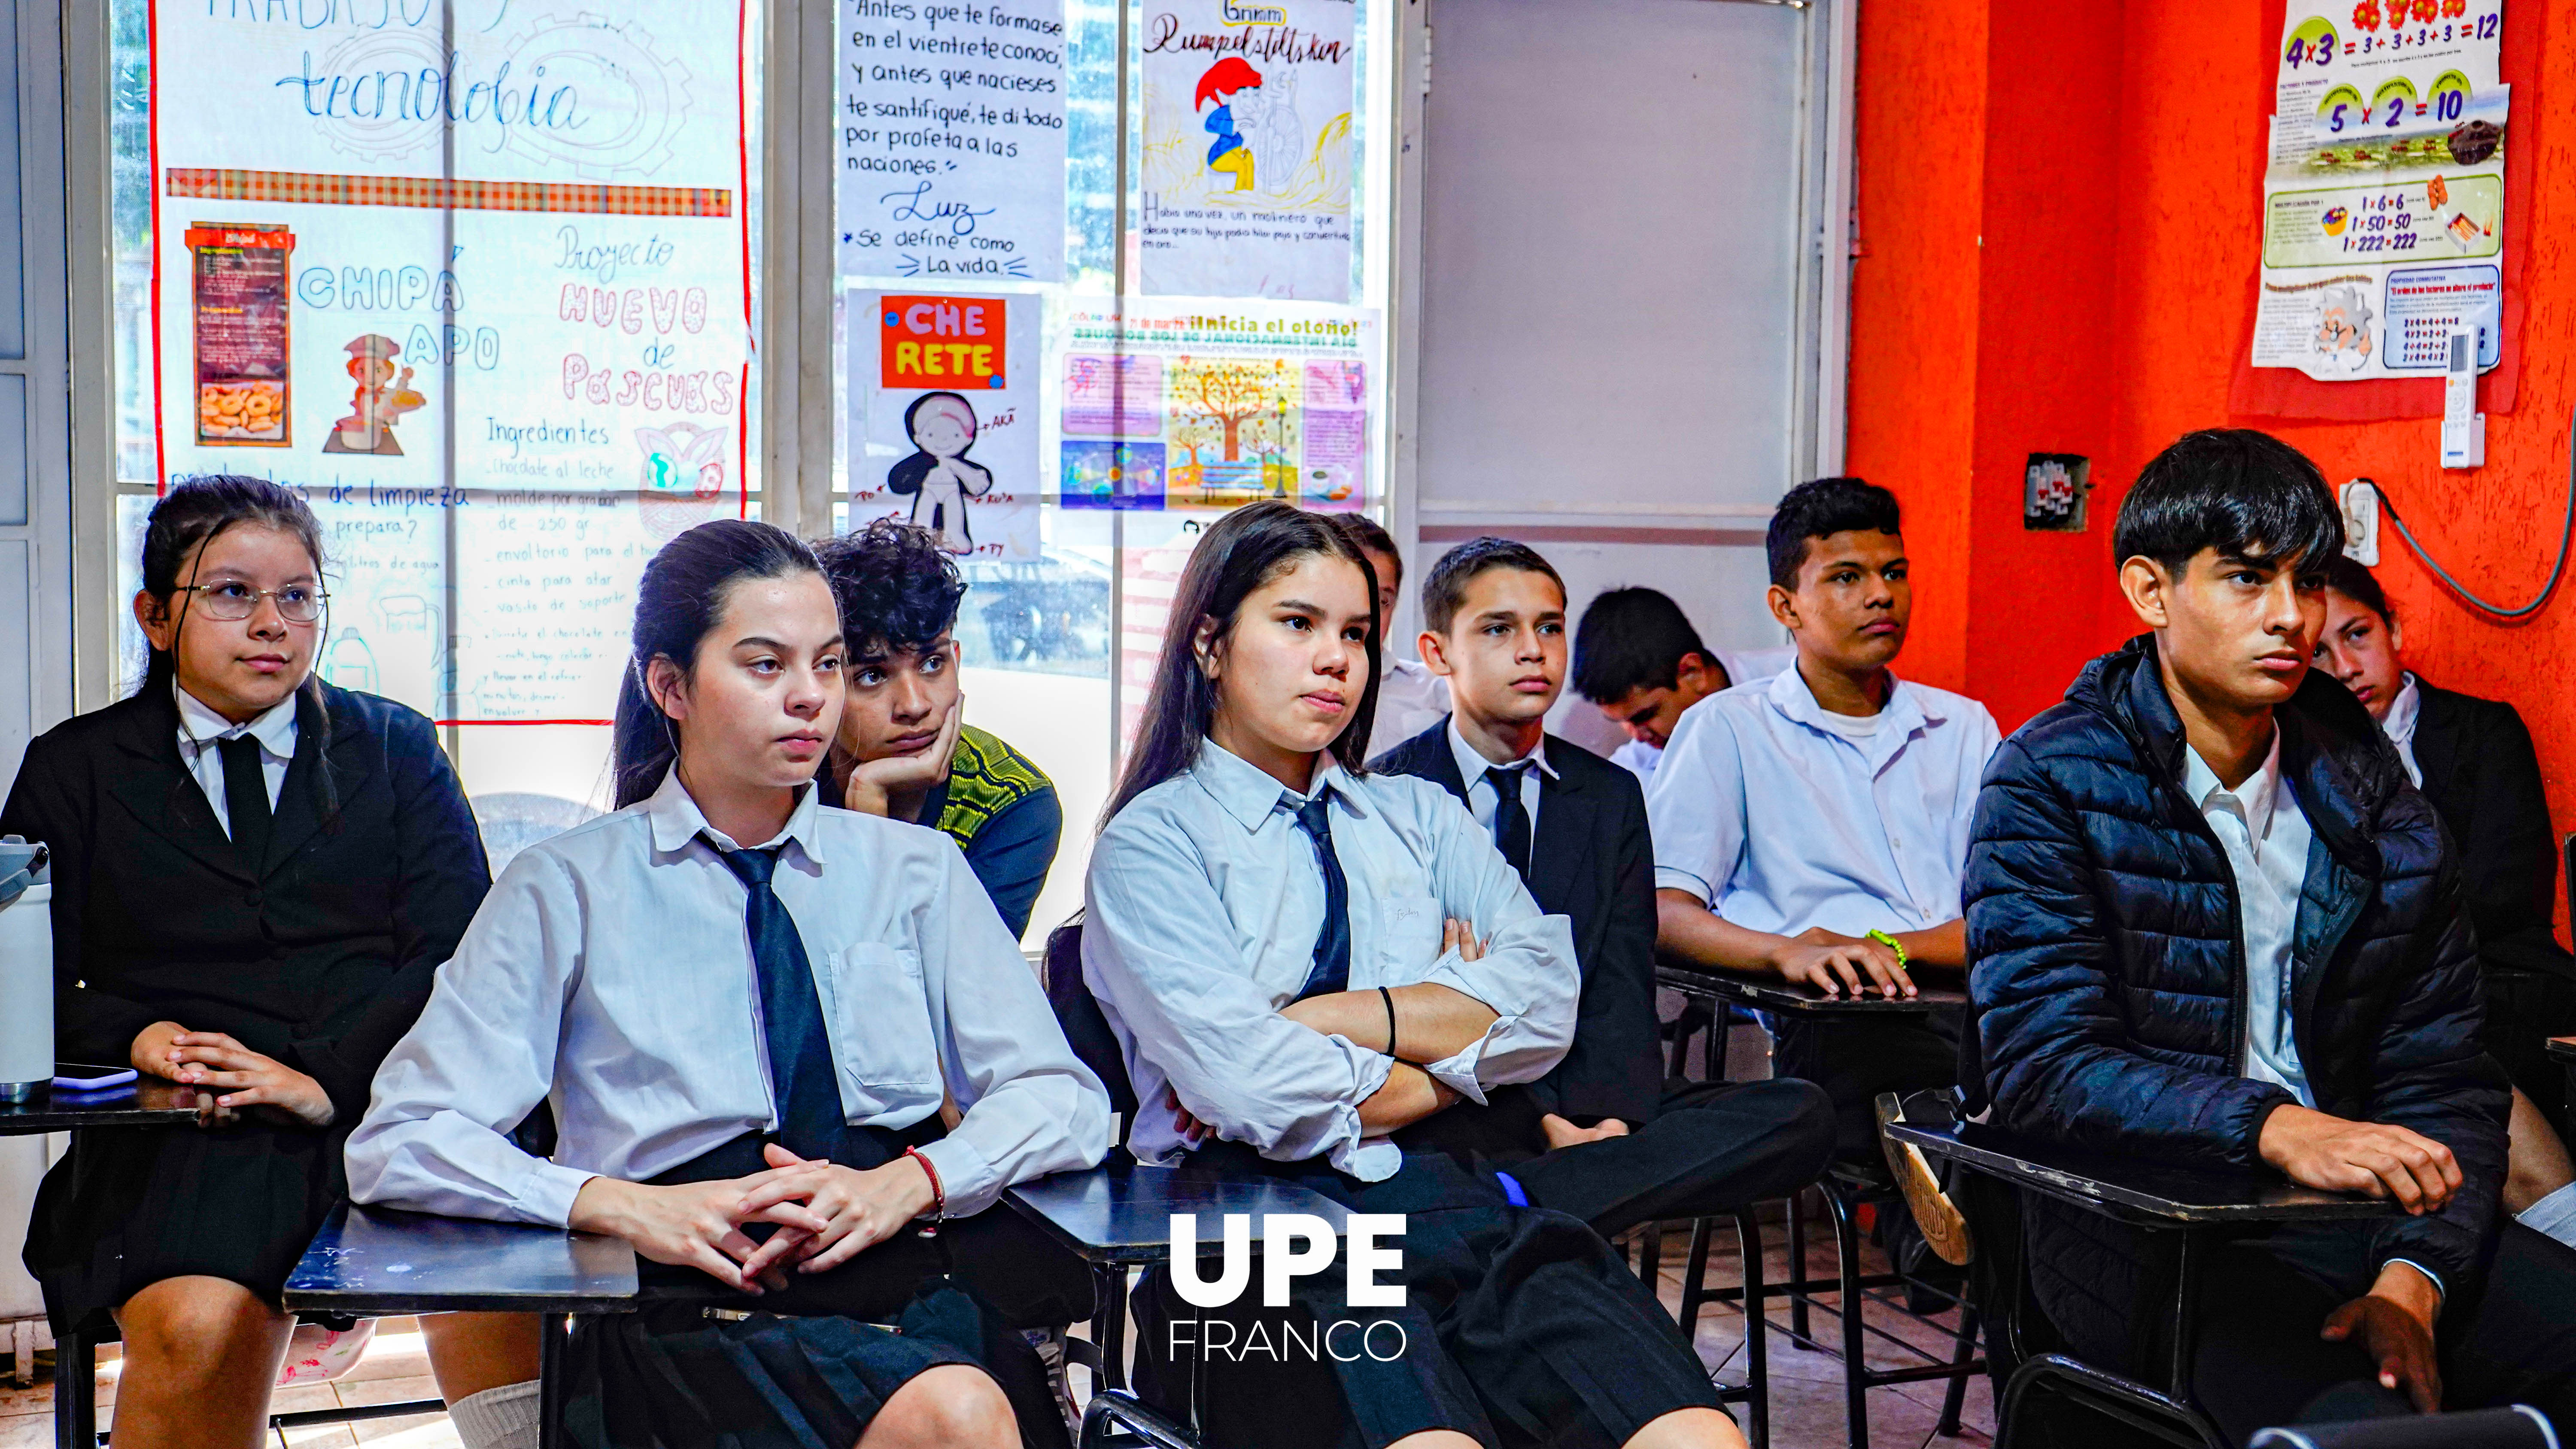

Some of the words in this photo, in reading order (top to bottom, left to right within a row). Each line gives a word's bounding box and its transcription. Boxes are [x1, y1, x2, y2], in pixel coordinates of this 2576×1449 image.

[925, 5, 959, 31] que
[964, 3, 983, 24] te
[990, 6, 1063, 36] formase
[2477, 13, 2498, 40] 12
[853, 31, 876, 48] en
[884, 30, 901, 49] el
[909, 36, 978, 56] vientre
[981, 37, 999, 59] te
[872, 65, 931, 84] antes
[940, 69, 972, 90] que
[978, 72, 1056, 93] nacieses
[846, 94, 868, 117] te
[979, 104, 997, 124] te
[1003, 109, 1018, 124] di
[1022, 107, 1063, 129] todo
[2330, 103, 2348, 133] 5
[2385, 98, 2403, 128] 2
[2438, 90, 2463, 122] 10
[846, 126, 880, 147] por
[889, 127, 962, 151] profeta
[966, 137, 980, 152] a
[987, 137, 1018, 158] las
[880, 181, 996, 235] Luz
[1230, 211, 1247, 221] un
[1314, 215, 1334, 230] que
[555, 225, 674, 284] Proyecto
[856, 229, 882, 247] Se
[895, 228, 959, 250] define
[970, 236, 1015, 252] como
[927, 256, 951, 273] La
[560, 283, 707, 334] HUEVO
[905, 303, 987, 337] CHE
[1266, 318, 1284, 333] el
[1292, 319, 1358, 336] otoño!
[405, 324, 499, 370] APO
[644, 337, 675, 369] de
[896, 341, 993, 377] RETE
[487, 417, 609, 458] Ingredientes
[330, 473, 353, 505] de
[370, 478, 469, 516] limpieza
